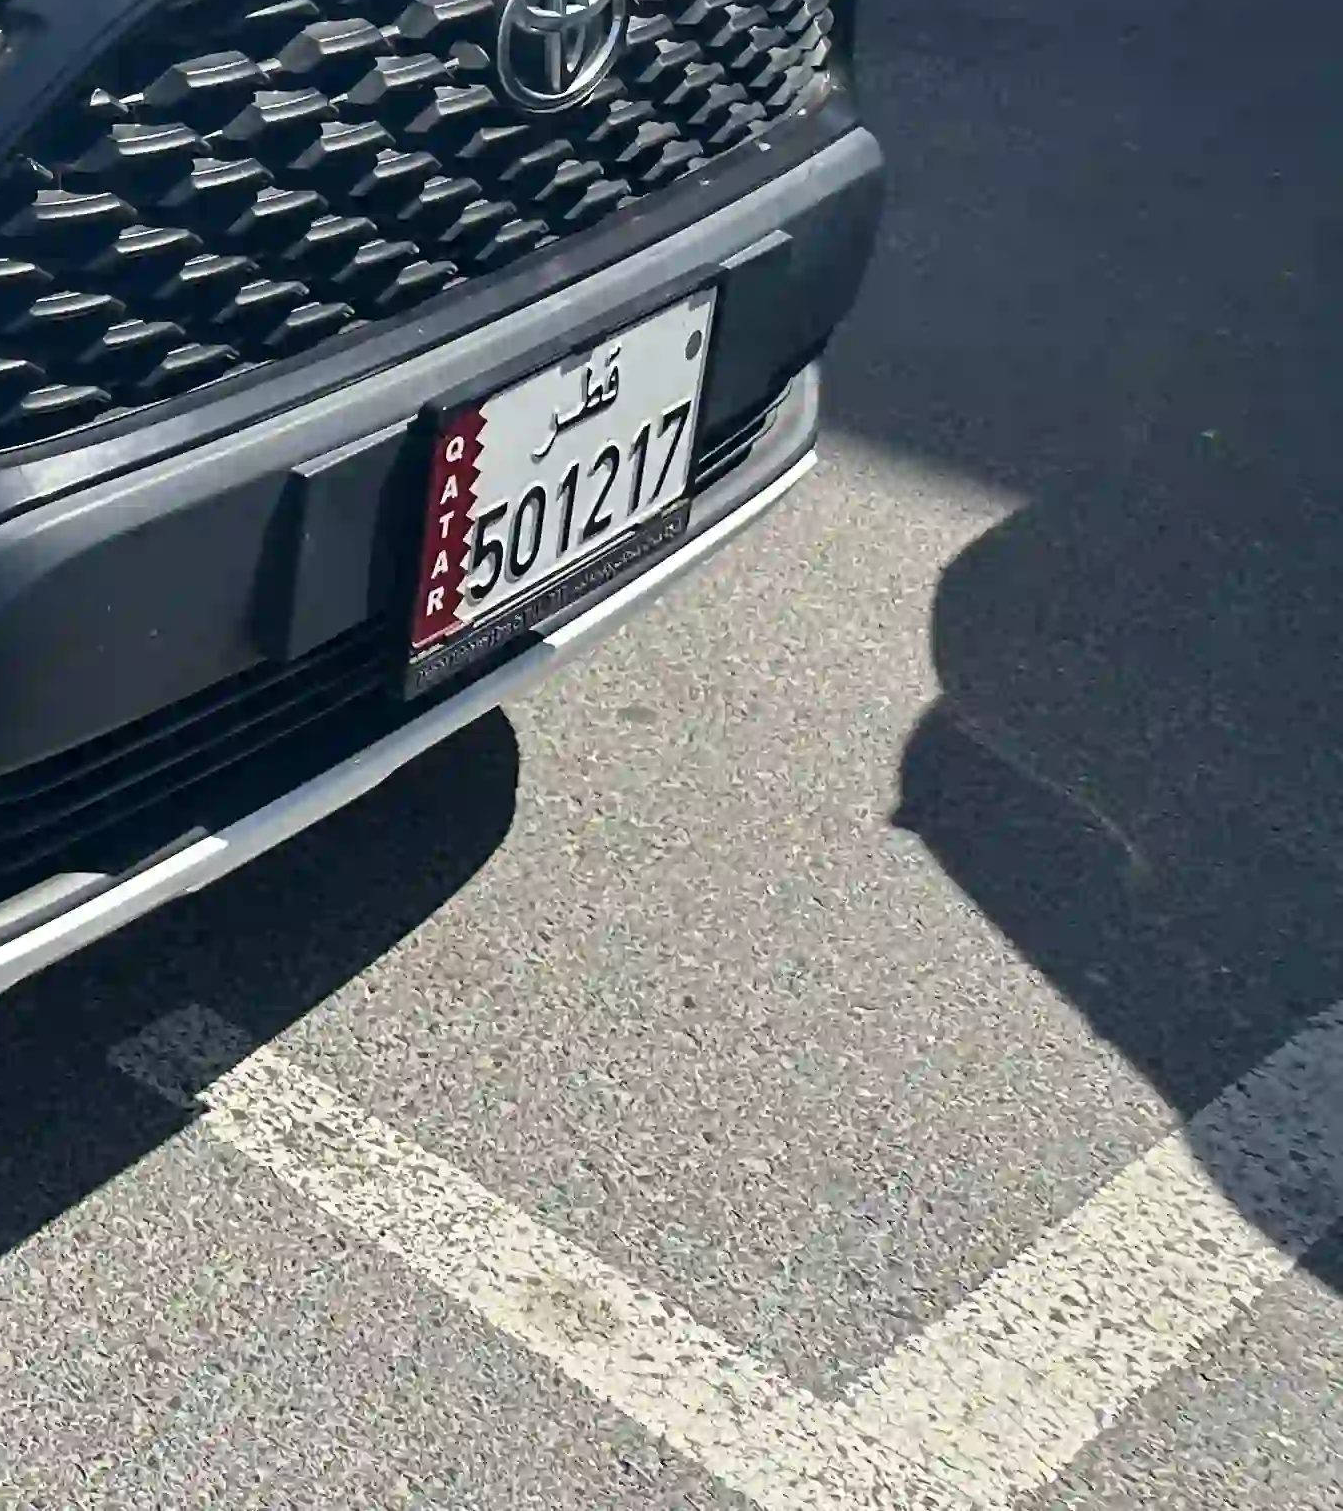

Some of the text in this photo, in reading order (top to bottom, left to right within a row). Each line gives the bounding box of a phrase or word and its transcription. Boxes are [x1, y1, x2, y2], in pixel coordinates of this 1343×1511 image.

[531, 342, 622, 463] قطر
[426, 435, 466, 617] QATAR
[467, 398, 692, 601] 501217
